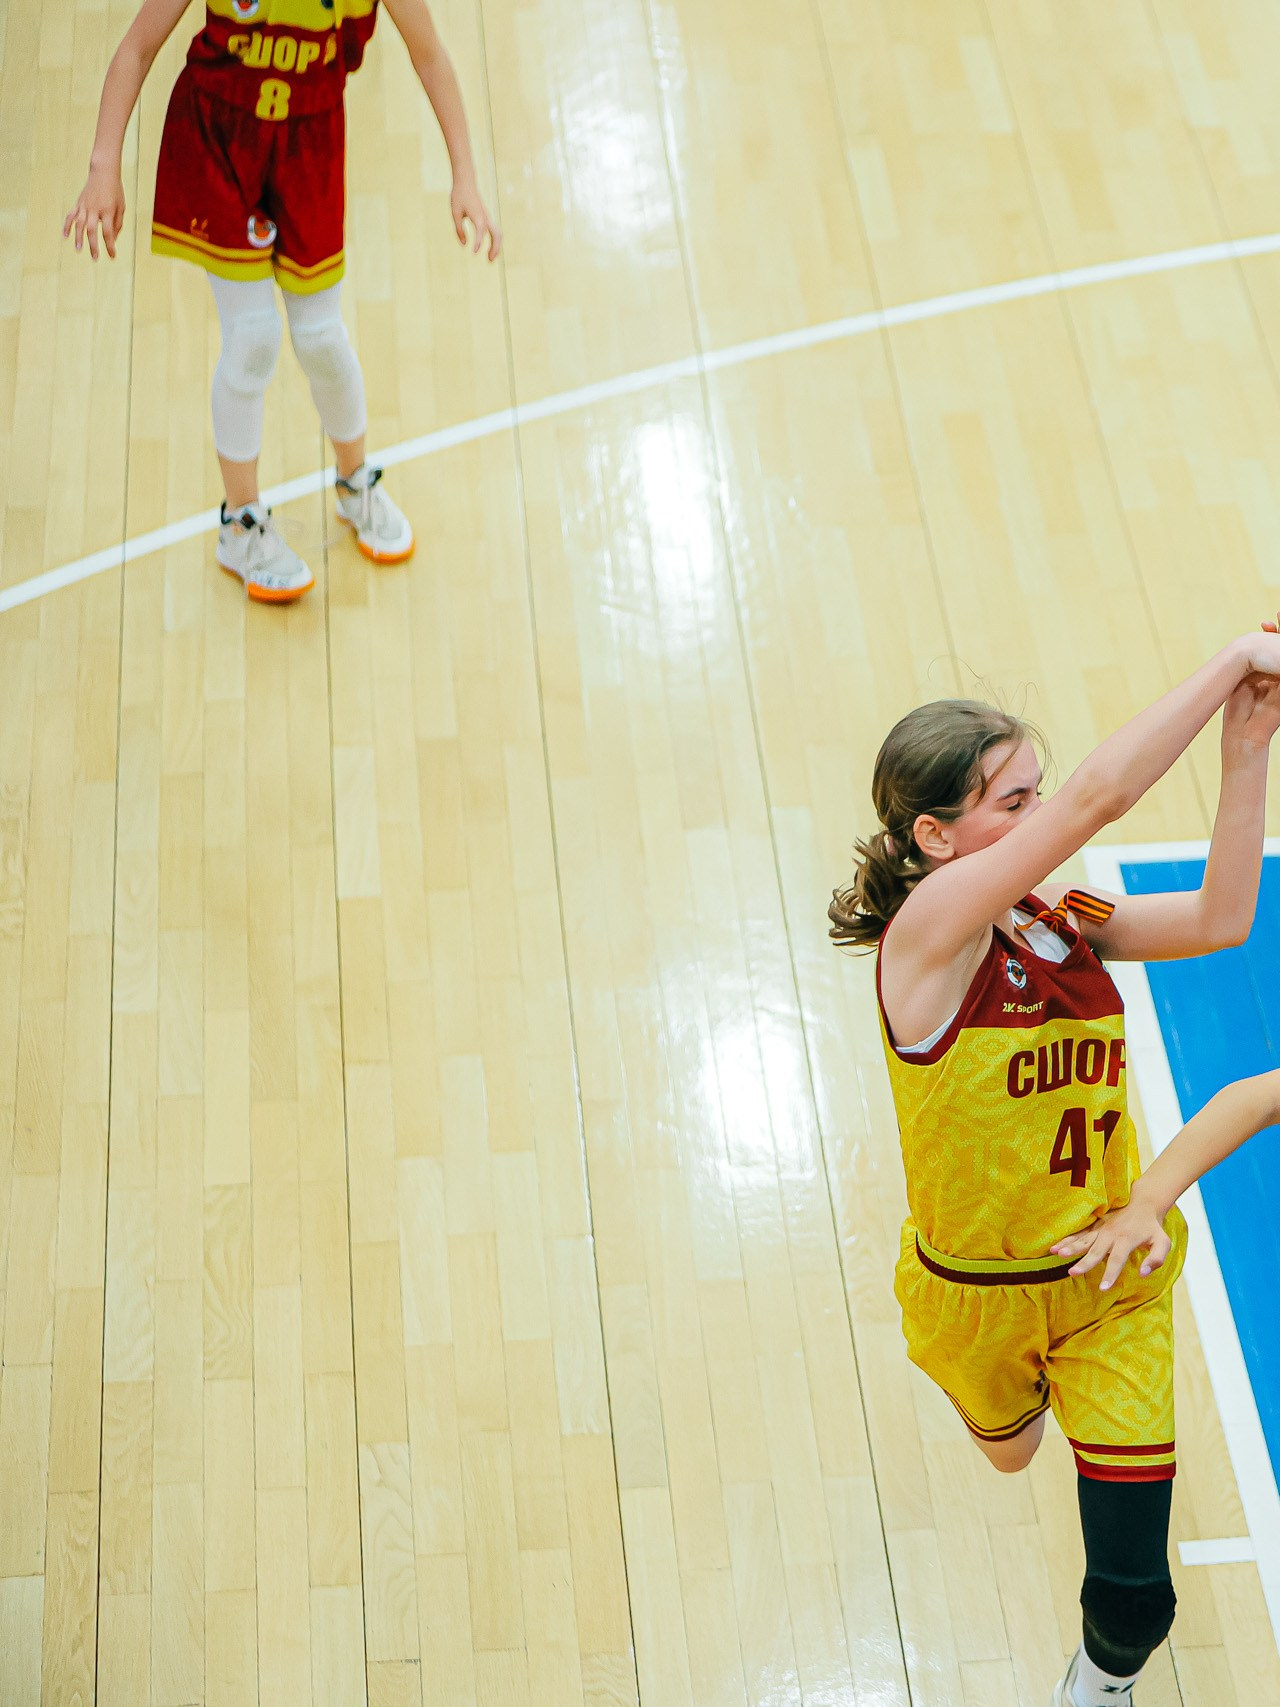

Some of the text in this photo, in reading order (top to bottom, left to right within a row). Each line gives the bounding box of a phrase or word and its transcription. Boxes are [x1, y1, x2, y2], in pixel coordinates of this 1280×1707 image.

[255, 77, 291, 121] 8
[1016, 1000, 1044, 1014] SPORT
[1007, 1038, 1126, 1098] СШОР
[1050, 1107, 1122, 1188] 41
